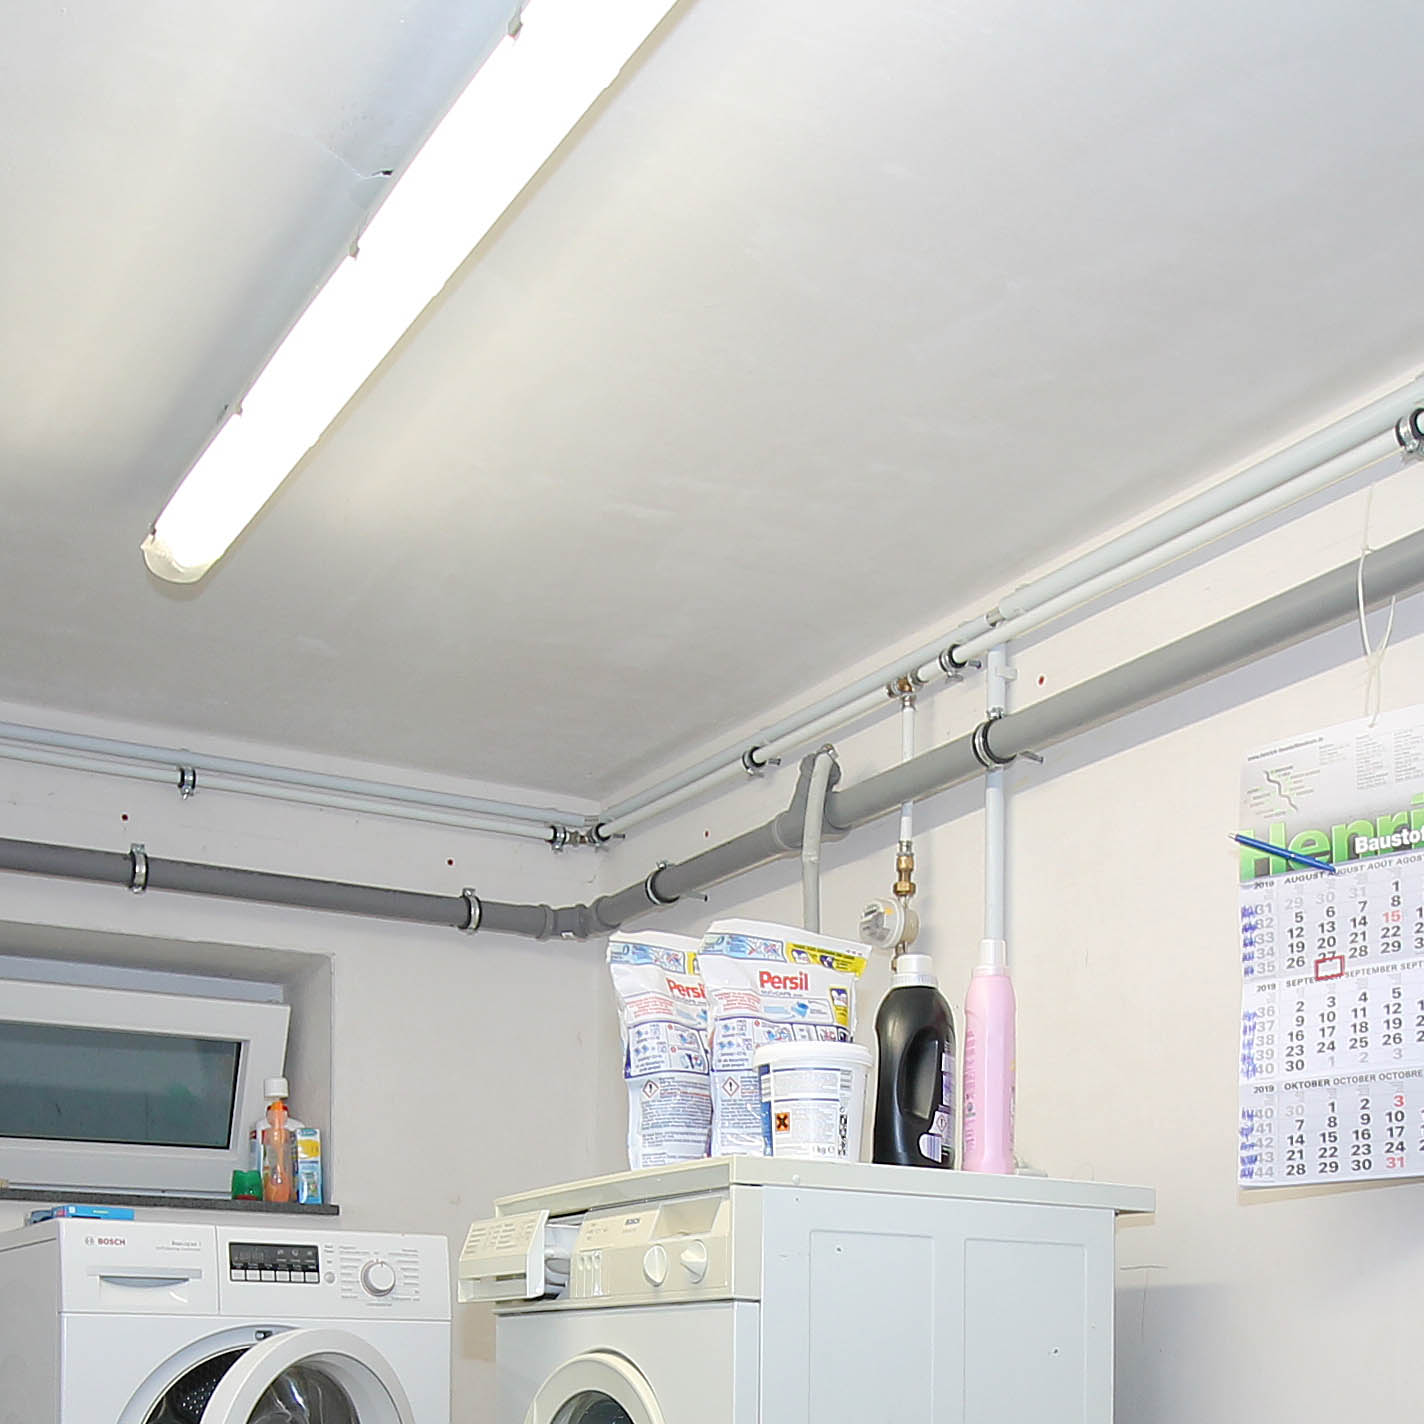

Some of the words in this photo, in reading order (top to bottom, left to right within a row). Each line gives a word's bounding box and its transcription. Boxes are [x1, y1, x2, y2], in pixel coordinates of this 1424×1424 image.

[1254, 880, 1274, 890] 2019
[1284, 871, 1324, 884] AUGUST
[1392, 881, 1399, 891] 1
[1295, 911, 1303, 923] 5
[1326, 906, 1335, 917] 6
[1358, 900, 1367, 912] 7
[1391, 895, 1401, 907] 8
[1288, 927, 1304, 939] 12
[1319, 921, 1335, 933] 13
[1350, 916, 1368, 928] 14
[1383, 910, 1400, 923] 15
[1288, 941, 1305, 954] 19
[1318, 936, 1336, 949] 20
[1350, 931, 1366, 944] 21
[1381, 926, 1400, 939] 22
[1287, 956, 1305, 969] 26
[1349, 945, 1368, 959] 28
[1381, 941, 1401, 953] 29
[759, 971, 808, 990] Persil
[1256, 983, 1276, 992] 2019
[1346, 963, 1398, 977] SEPTEMBER
[666, 978, 707, 999] Persi
[1296, 1001, 1304, 1012] 2
[1327, 996, 1336, 1008] 3
[1359, 992, 1368, 1002] 4
[1392, 987, 1401, 999] 5
[1296, 1016, 1304, 1027] 9
[1319, 1011, 1336, 1023] 10
[1352, 1007, 1366, 1018] 11
[1384, 1003, 1401, 1015] 12
[1288, 1030, 1304, 1042] 16
[1320, 1026, 1335, 1038] 17
[1351, 1021, 1368, 1033] 18
[1384, 1017, 1402, 1030] 19
[1286, 1045, 1304, 1057] 23
[1317, 1041, 1335, 1053] 24
[1349, 1037, 1368, 1049] 25
[1383, 1033, 1402, 1046] 26
[1286, 1059, 1304, 1071] 30
[1253, 1085, 1274, 1094] 2019
[1284, 1079, 1330, 1091] OKTOBER
[1333, 1074, 1376, 1085] OCTOBER
[1379, 1070, 1423, 1081] OCTOBRE
[1329, 1102, 1335, 1113] 1
[1360, 1099, 1369, 1110] 2
[1394, 1095, 1404, 1107] 3
[1295, 1119, 1304, 1130] 7
[1328, 1116, 1337, 1128] 8
[1361, 1113, 1370, 1125] 9
[1386, 1111, 1404, 1122] 10
[1288, 1134, 1305, 1146] 14
[1320, 1131, 1337, 1143] 15
[1353, 1129, 1371, 1140] 16
[1387, 1126, 1404, 1138] 17
[1287, 1149, 1303, 1161] 21
[1319, 1147, 1338, 1158] 22
[1352, 1144, 1371, 1156] 23
[1385, 1141, 1406, 1153] 24
[1287, 1164, 1306, 1175] 28
[1319, 1161, 1338, 1173] 29
[1352, 1159, 1371, 1171] 30
[1386, 1157, 1404, 1168] 31
[98, 1238, 125, 1246] BOSCH
